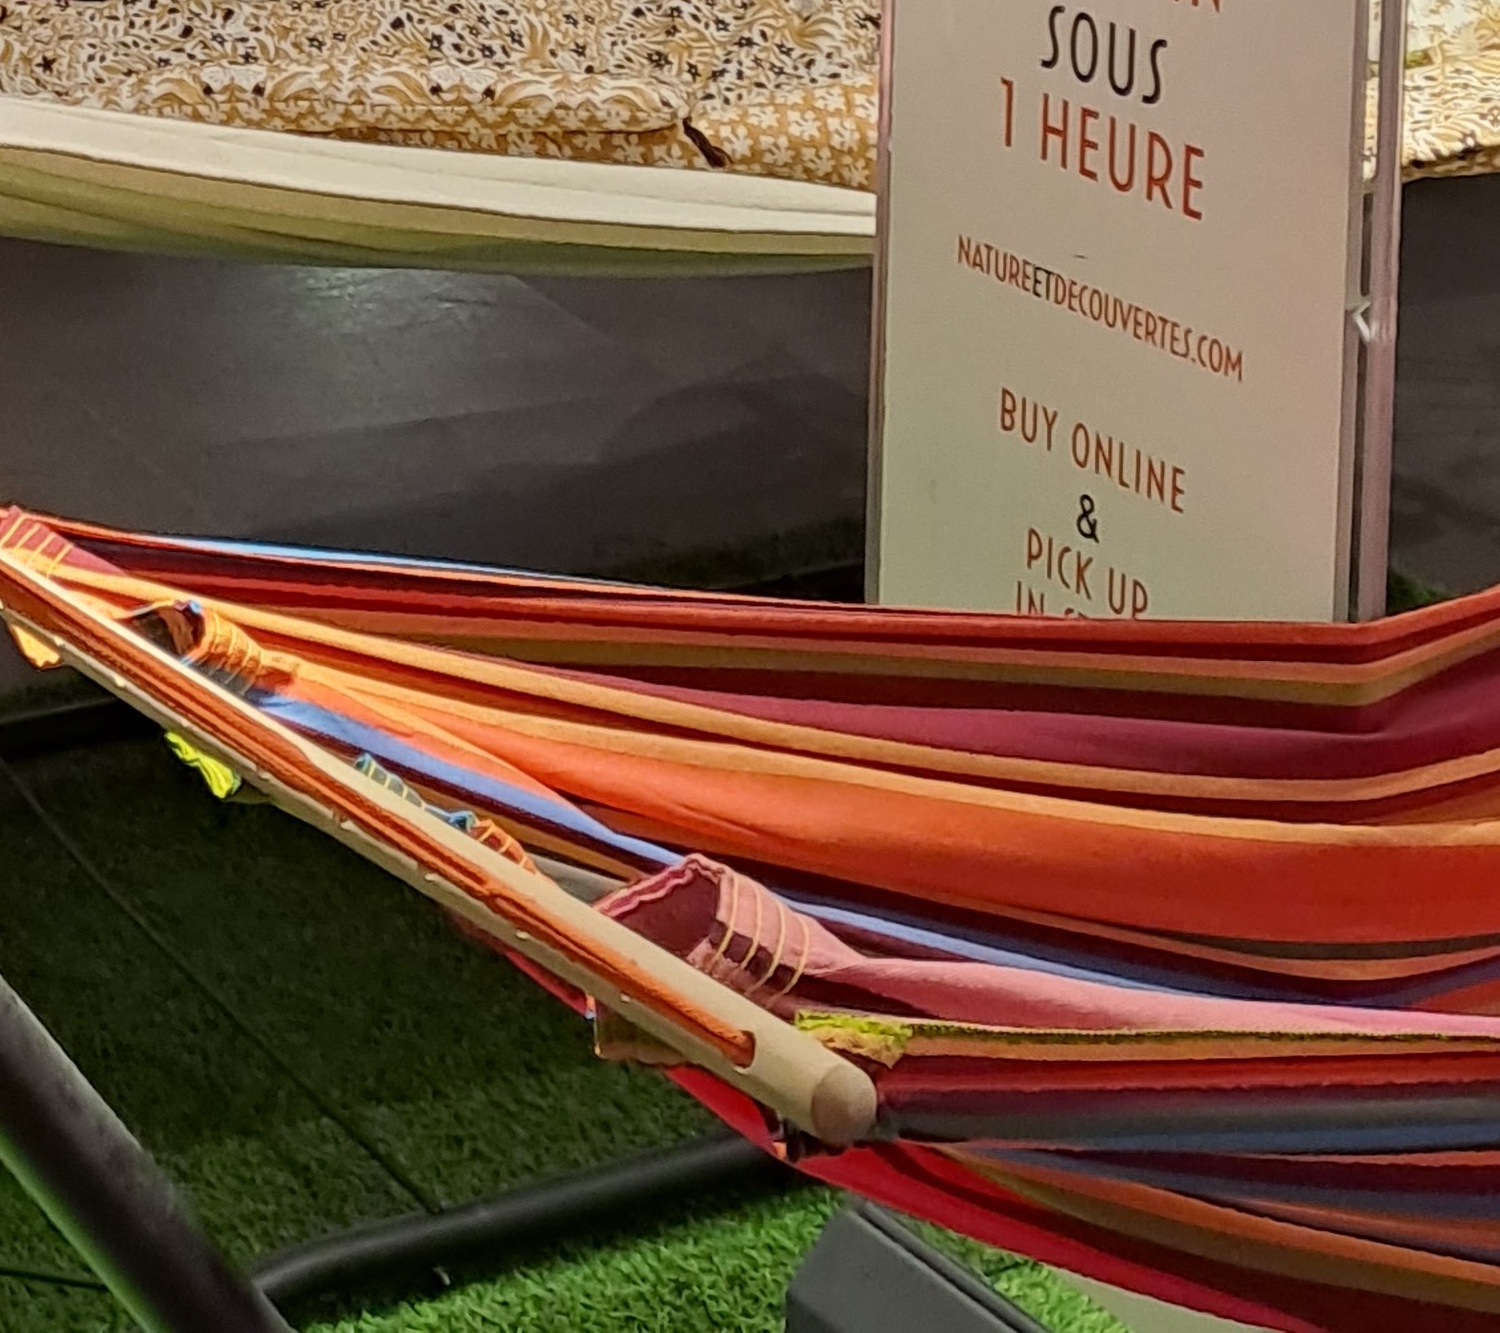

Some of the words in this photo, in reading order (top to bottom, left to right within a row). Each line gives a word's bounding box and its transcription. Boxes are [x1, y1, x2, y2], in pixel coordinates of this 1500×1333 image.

[1040, 4, 1168, 105] SOUS
[1001, 77, 1014, 147] 1
[1040, 92, 1205, 221] HEURE
[957, 233, 1243, 383] NATUREETDECOUVERTES.COM
[1001, 387, 1058, 452] BUY
[1071, 422, 1186, 514] ONLINE
[1076, 494, 1100, 544] &
[1016, 580, 1045, 616] IN
[1027, 527, 1093, 601] PICK
[1108, 567, 1149, 620] UP
